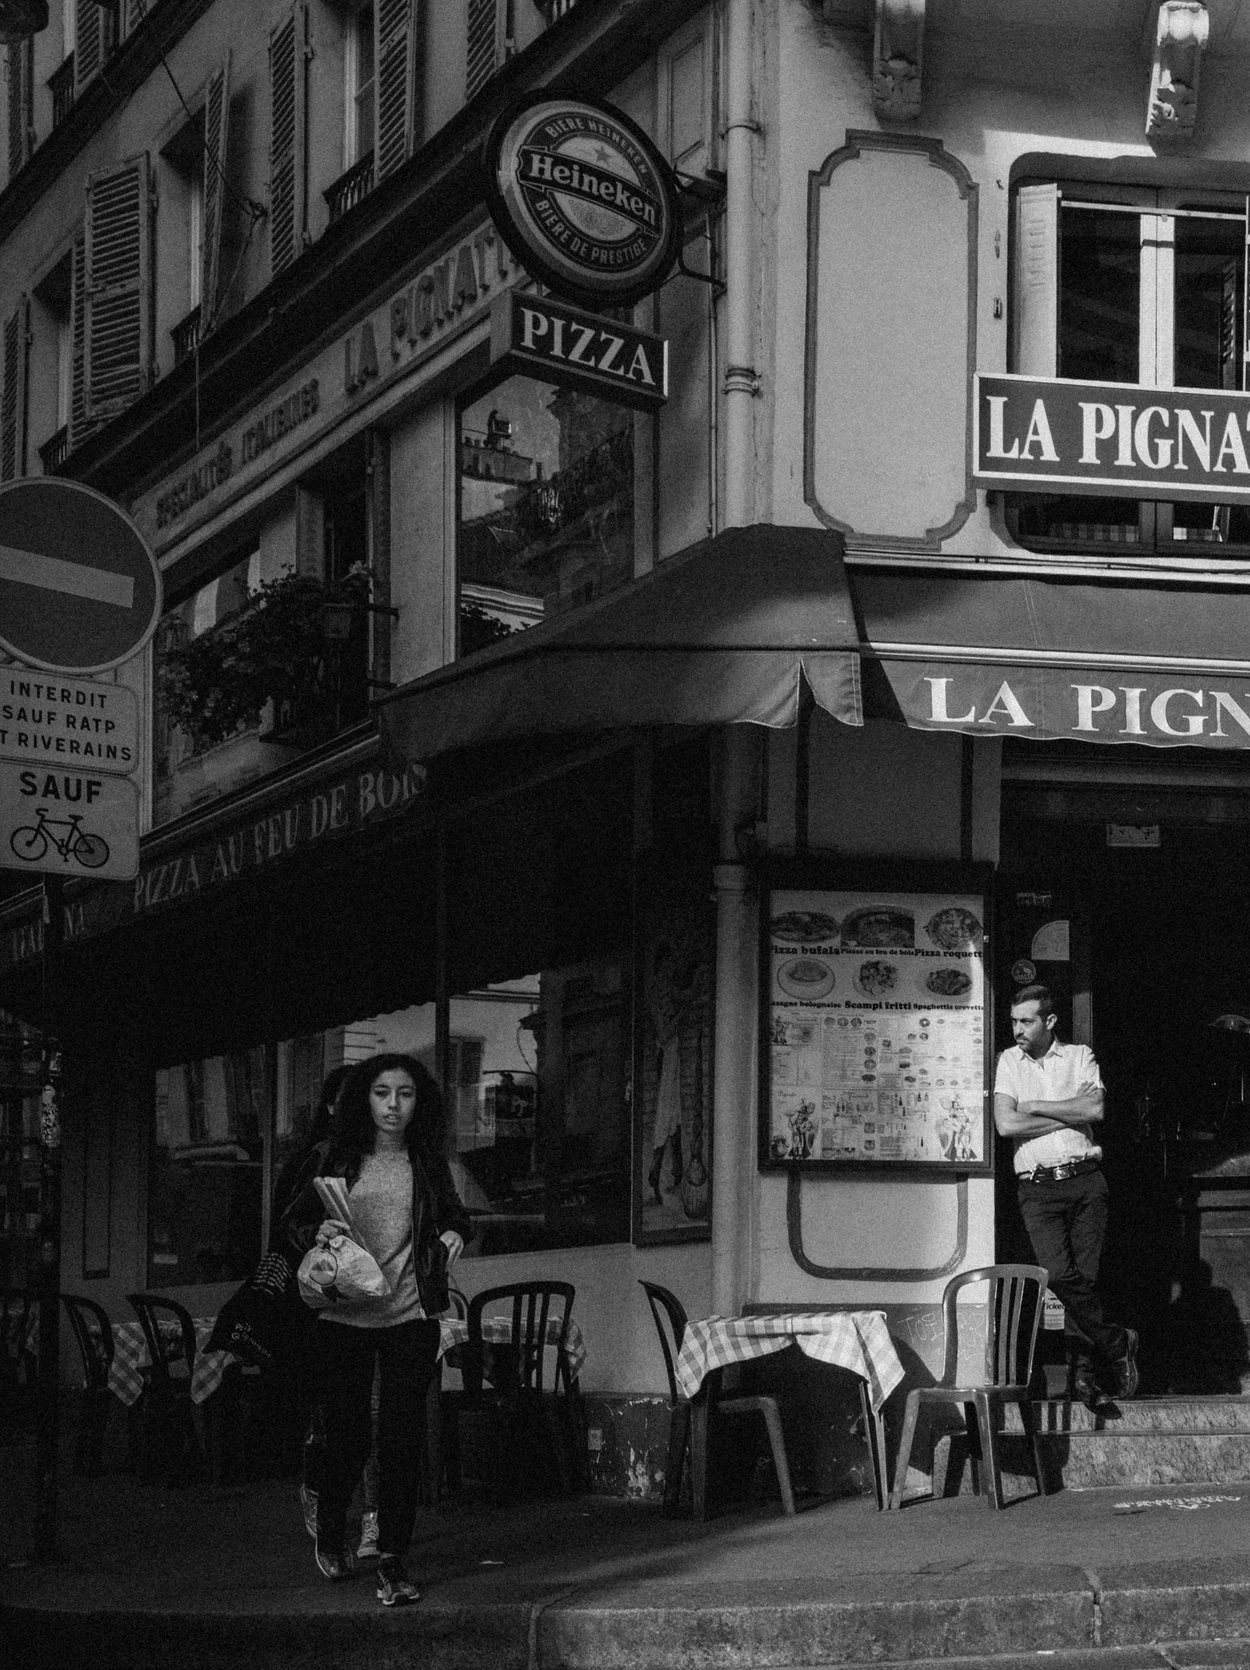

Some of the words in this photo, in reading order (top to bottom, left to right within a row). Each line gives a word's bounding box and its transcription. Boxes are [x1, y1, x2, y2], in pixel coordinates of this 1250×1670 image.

[588, 117, 648, 175] HEINEKEN
[528, 152, 658, 227] Heineken
[534, 199, 570, 245] BIERE
[569, 236, 589, 258] DE
[590, 236, 648, 266] PRESTIGE
[519, 306, 657, 387] PIZZA
[985, 395, 1061, 463] LA
[9, 679, 108, 709] INTERDIT
[923, 677, 1036, 729] LA
[2, 704, 58, 727] SAUF
[66, 713, 116, 735] RATP
[17, 732, 133, 761] RIVERAINS
[19, 770, 103, 803] SAUF
[132, 853, 199, 914] PIZZA
[209, 831, 245, 883] AU
[253, 808, 300, 864] FEU
[309, 783, 350, 841] DE
[772, 945, 798, 955] izza
[801, 945, 840, 956] bufala
[914, 948, 941, 957] Pizza
[943, 950, 983, 959] roquett
[770, 1001, 798, 1009] asagne
[844, 1000, 883, 1011] Scampi
[885, 1001, 911, 1010] fritti
